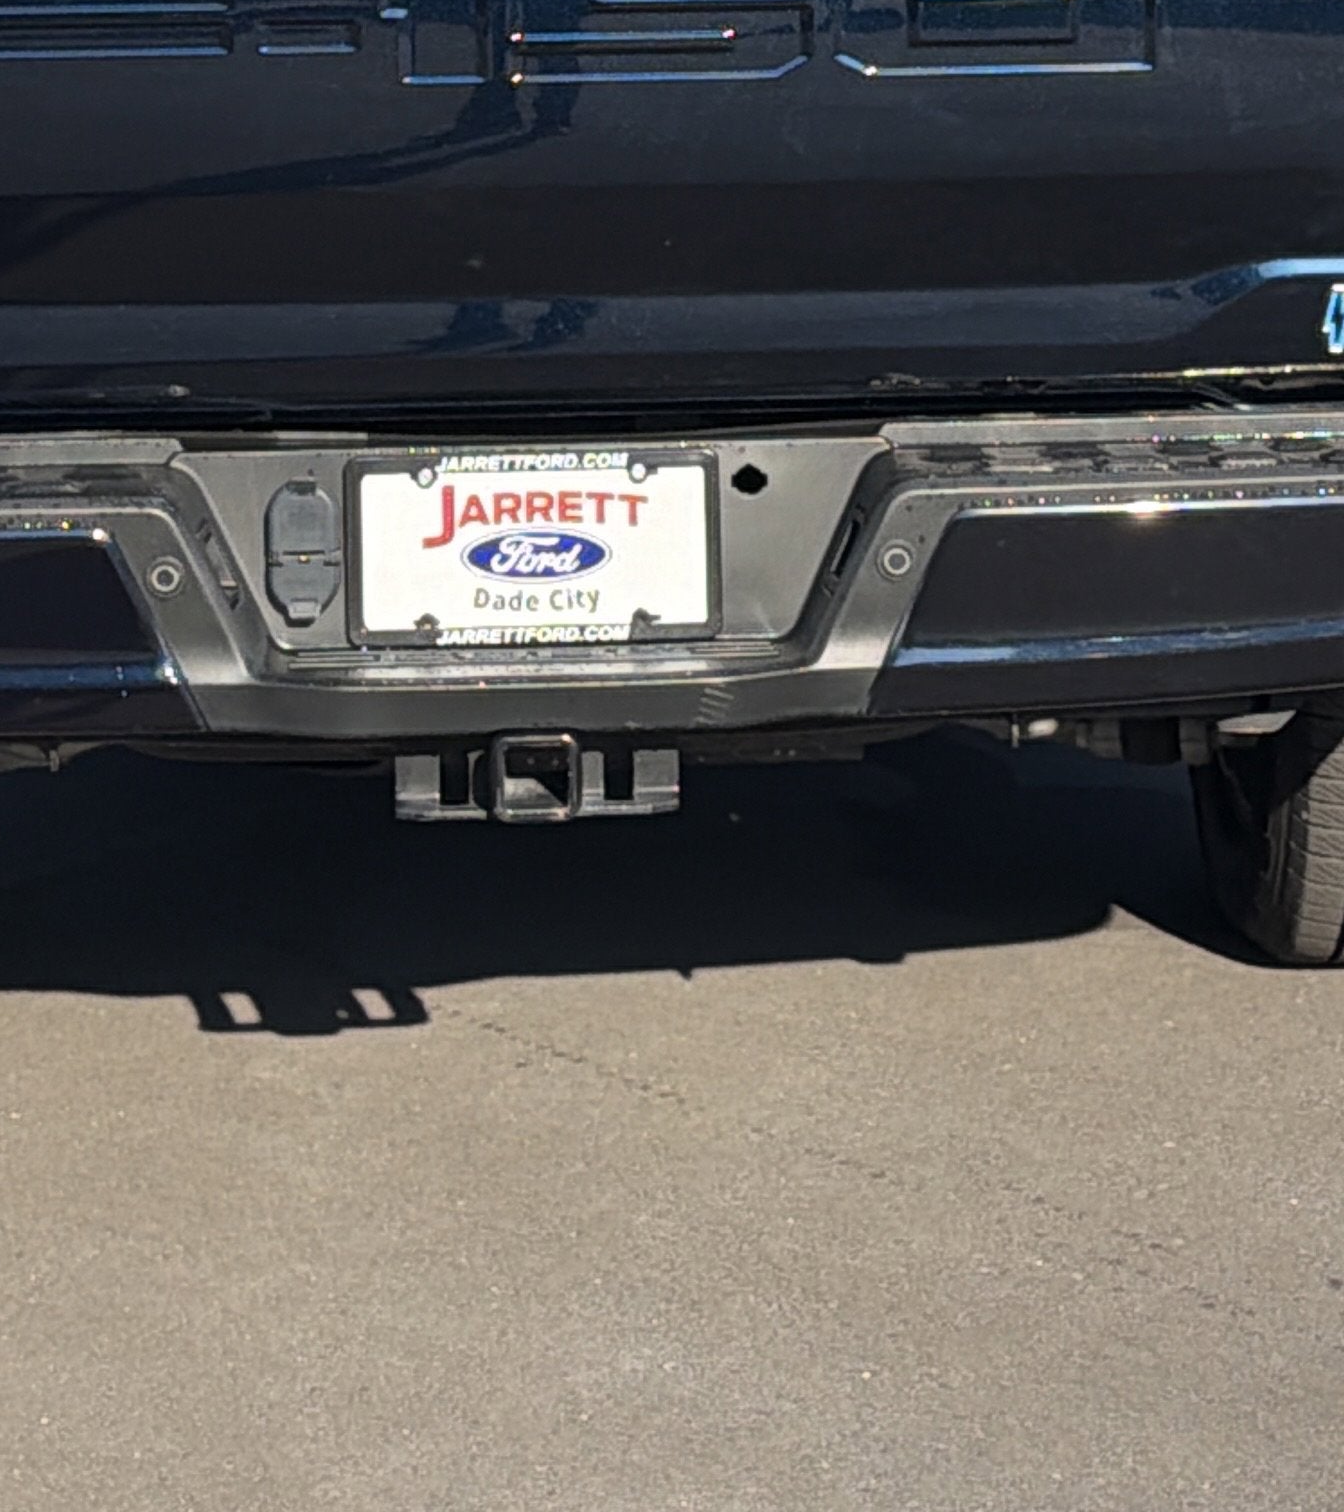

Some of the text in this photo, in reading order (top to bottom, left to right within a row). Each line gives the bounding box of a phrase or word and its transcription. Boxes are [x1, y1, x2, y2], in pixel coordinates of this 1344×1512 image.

[435, 452, 630, 473] JARRETTFORD.COM
[422, 485, 649, 549] JARRETT
[490, 534, 581, 573] Ford
[473, 588, 601, 614] Dade City
[436, 624, 631, 646] JARRETTFORD.COM
